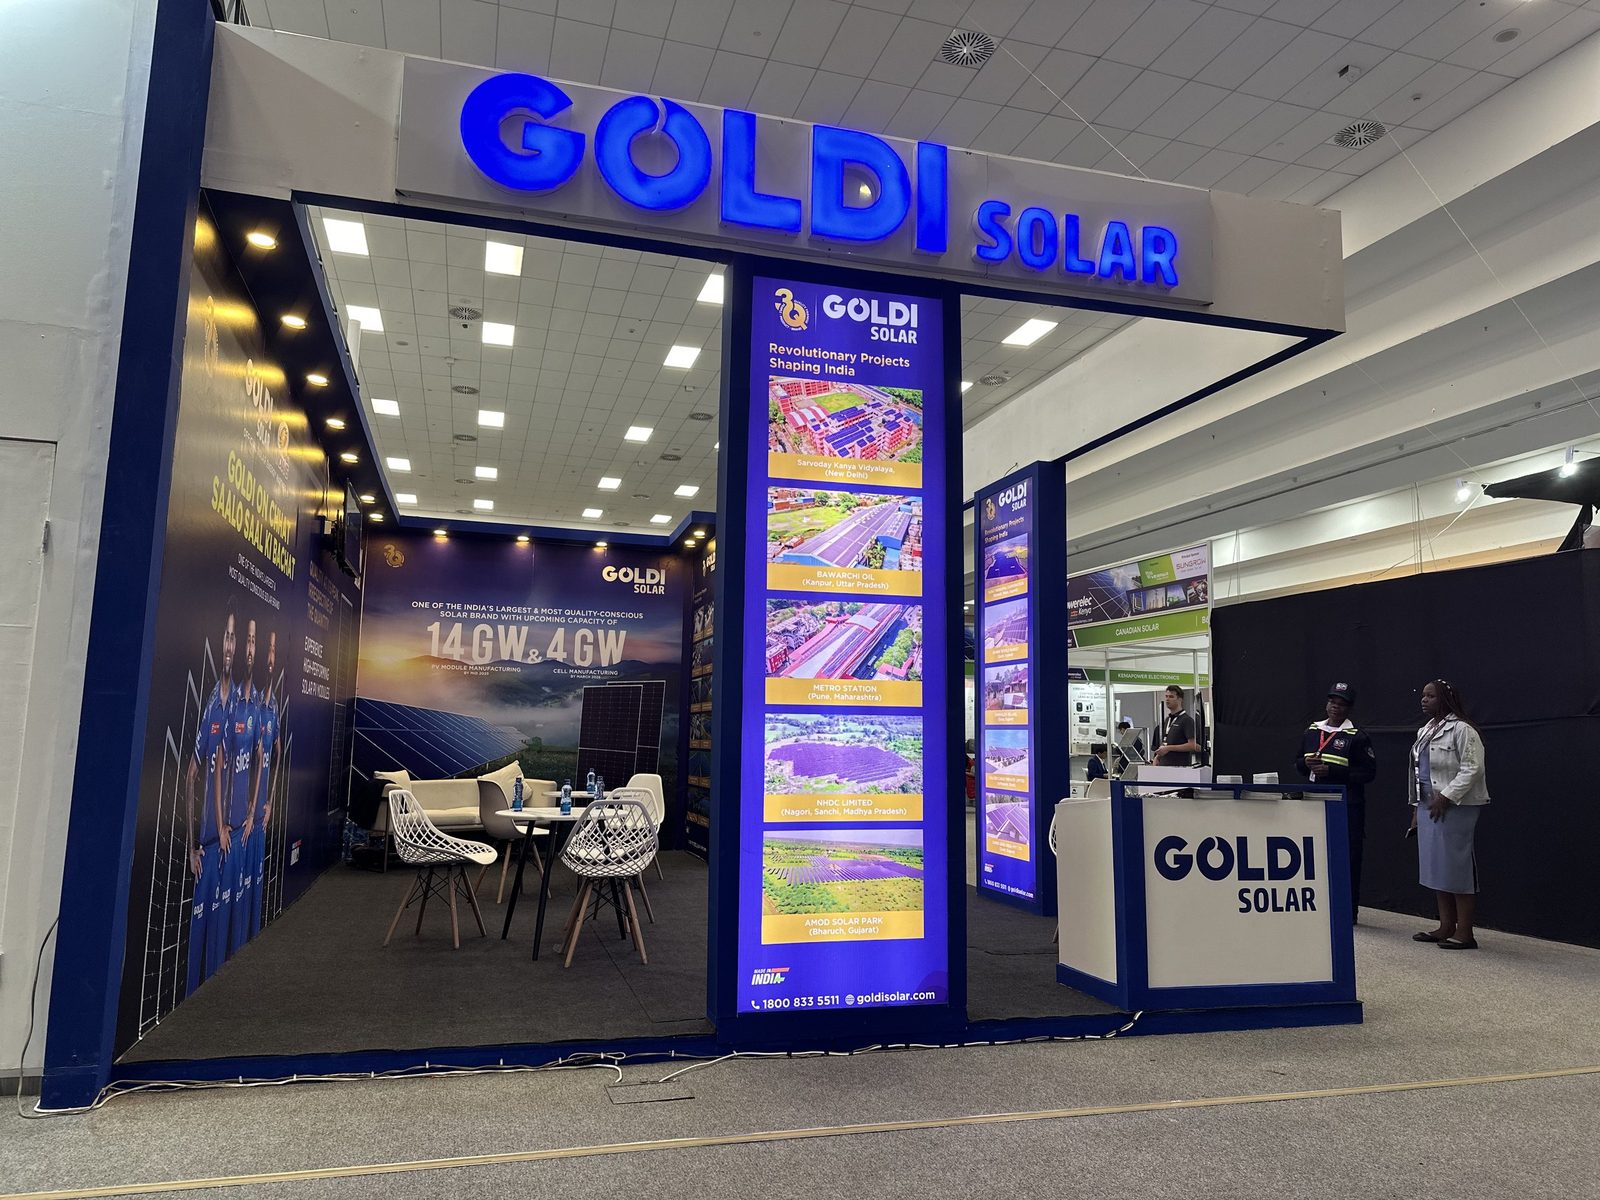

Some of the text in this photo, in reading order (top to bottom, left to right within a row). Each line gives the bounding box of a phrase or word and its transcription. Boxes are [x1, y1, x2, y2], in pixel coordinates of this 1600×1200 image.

[460, 73, 1179, 288] GOLDI SOLAR
[823, 294, 918, 328] GOLDI
[870, 327, 918, 344] SOLAR
[769, 343, 910, 368] Revolutionary Projects
[769, 358, 855, 376] Shaping India
[797, 460, 832, 469] Sarvoday
[833, 463, 857, 471] Kanya
[825, 469, 869, 479] (New Delhi)
[228, 449, 256, 507] GOLDI
[256, 484, 269, 521] ON
[998, 482, 1027, 507] GOLDI
[1011, 498, 1027, 512] SOLAR
[211, 475, 243, 532] SAALO
[243, 508, 264, 553] SAAL
[264, 529, 272, 560] KI
[272, 537, 296, 581] BACHAT
[1176, 559, 1207, 570] SUNGROW
[602, 566, 665, 585] GOLDI
[817, 571, 860, 580] BAWARCHI
[634, 584, 665, 595] SOLAR
[836, 579, 855, 587] Uttar
[857, 580, 889, 590] Pradesh)
[440, 610, 468, 618] SOLAR
[524, 615, 566, 623] UPCOMING
[568, 617, 605, 625] CAPACITY
[496, 606, 532, 614] LARGEST
[564, 609, 643, 619] QUALITY-CONSCIOUS
[1115, 626, 1142, 636] CANADIAN
[1141, 623, 1160, 632] SOLAR
[427, 621, 627, 667] 14 GW & 4 GW
[813, 684, 841, 692] METRO
[833, 692, 882, 702] Maharashtra)
[843, 808, 871, 817] Madhya
[874, 808, 907, 816] Pradesh)
[1154, 835, 1316, 881] GOLDI
[1238, 887, 1316, 913] SOLAR
[804, 917, 883, 927] AMOD SOLAR PARK
[848, 926, 879, 935] Gujarat)
[751, 972, 781, 985] INDIA
[763, 991, 936, 1009] 1800 833 5511 goldisolar.com
